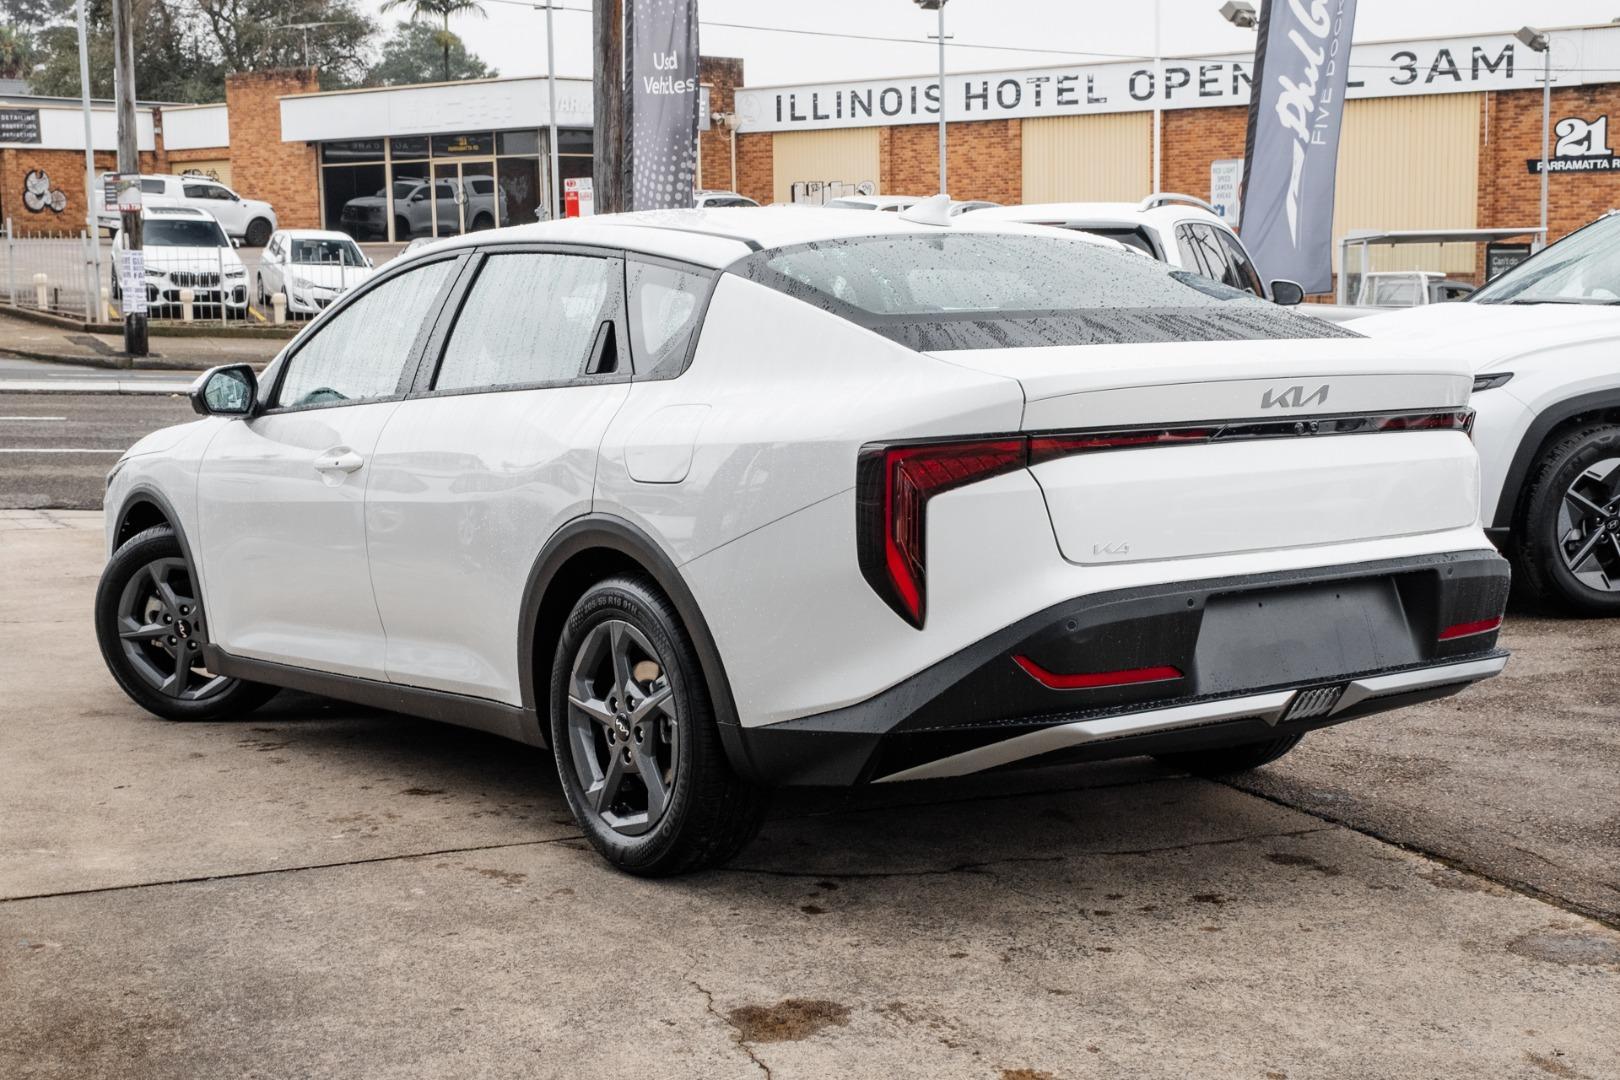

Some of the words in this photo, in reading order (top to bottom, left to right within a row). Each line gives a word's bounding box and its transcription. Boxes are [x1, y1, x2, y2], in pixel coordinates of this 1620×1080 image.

[653, 50, 678, 69] Usd
[1311, 88, 1333, 145] FIVE
[1325, 0, 1344, 76] DOCK
[776, 84, 940, 122] ILLINOIS
[965, 74, 1107, 111] HOTEL
[1129, 64, 1252, 101] OPEN
[1389, 44, 1514, 85] 3AM
[1554, 116, 1612, 156] 21
[1261, 384, 1330, 408] KIA
[1093, 542, 1129, 556] K4
